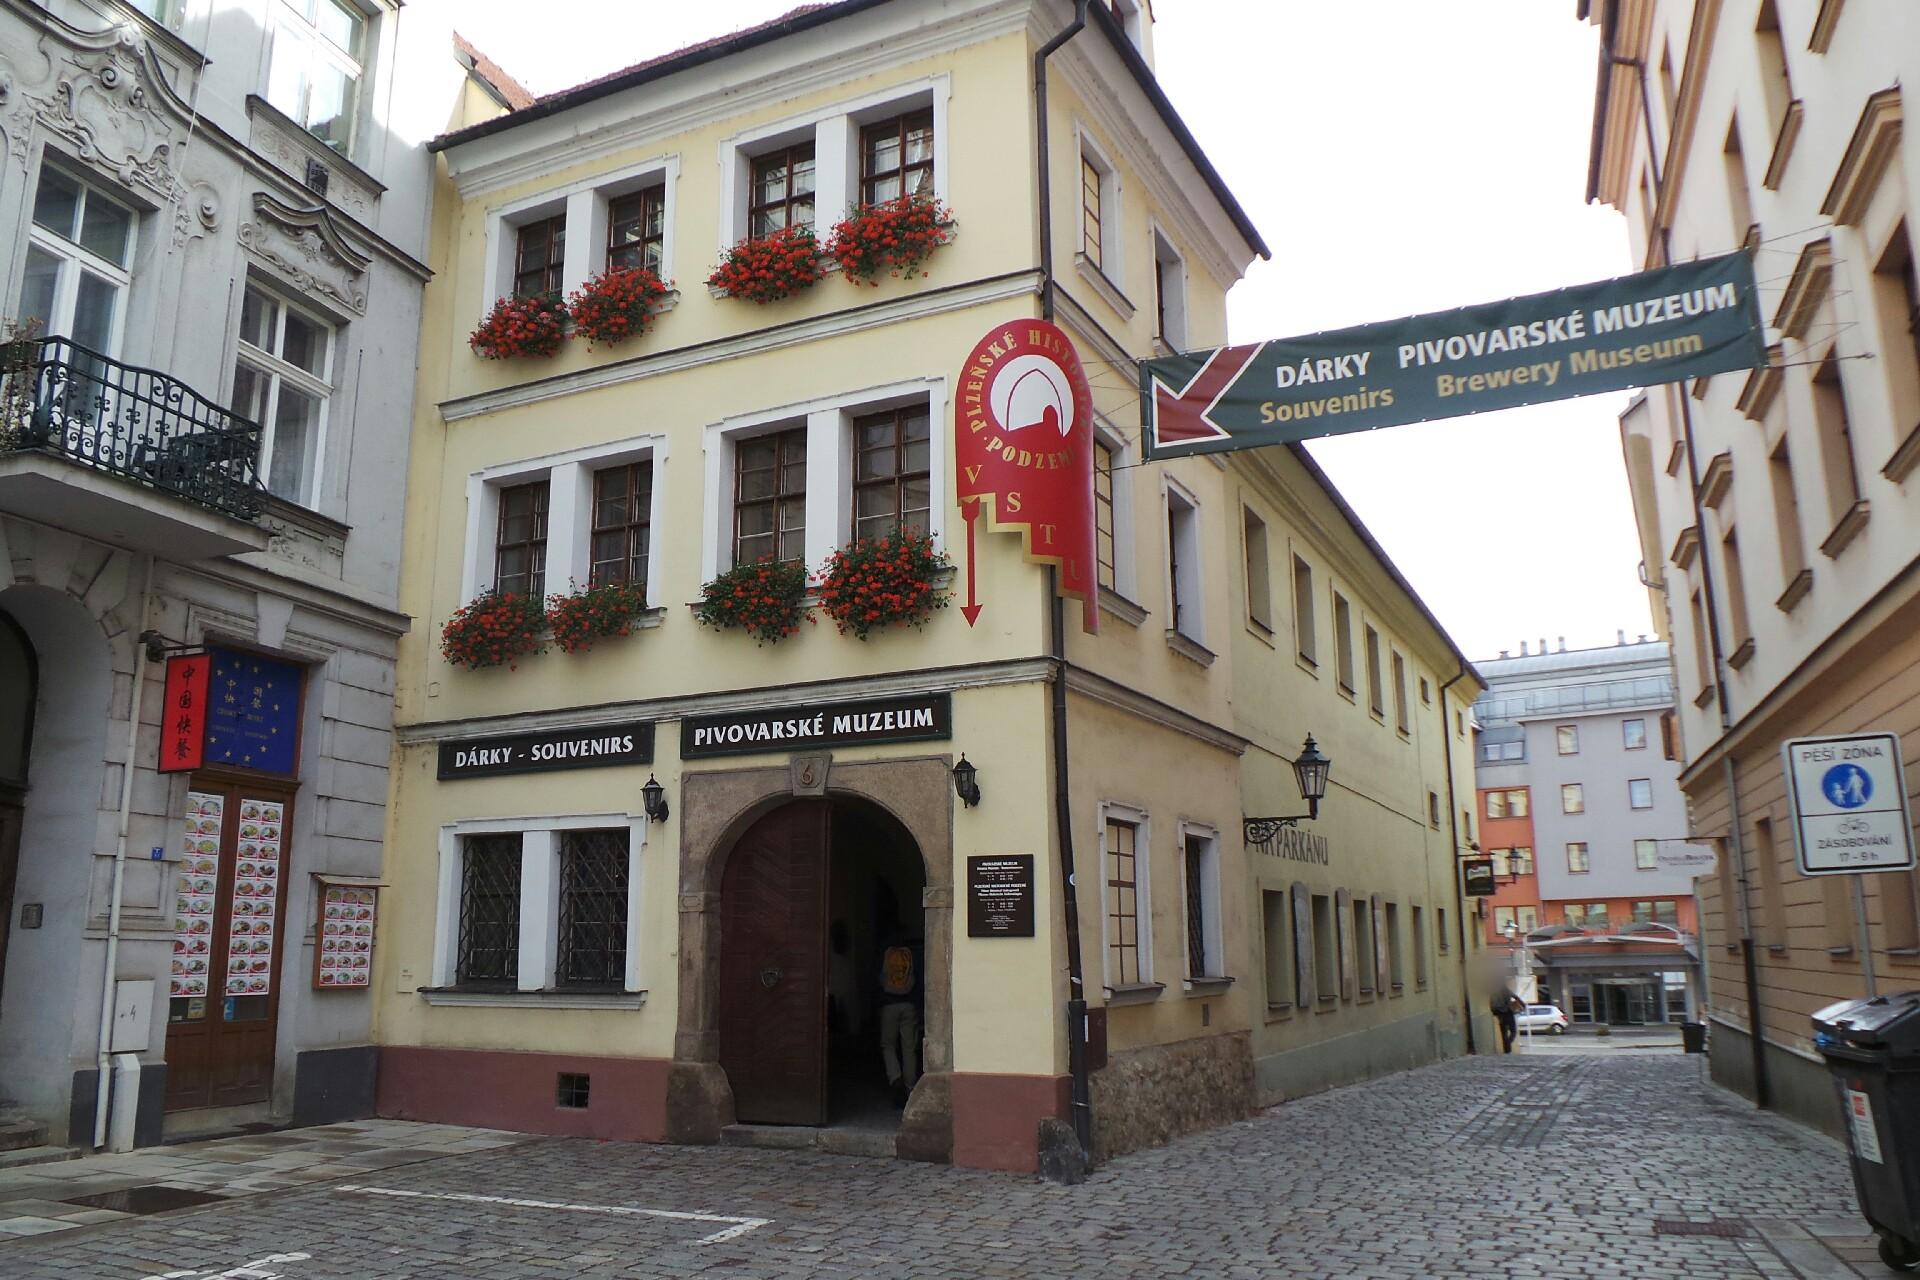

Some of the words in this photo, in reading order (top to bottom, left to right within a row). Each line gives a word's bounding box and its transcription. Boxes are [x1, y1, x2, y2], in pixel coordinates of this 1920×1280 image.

[1276, 351, 1370, 388] DÁRKY
[1398, 309, 1586, 369] PIVOVARSKÉ
[1593, 282, 1738, 335] MUZEUM
[965, 331, 1017, 434] PLZEŇSKÉ
[1260, 386, 1394, 424] Souvenirs
[1437, 358, 1562, 398] Brewery
[1570, 334, 1703, 375] Museum
[985, 435, 1076, 469] PODZEM
[694, 712, 824, 746] PIVOVARSKÉ
[832, 708, 934, 734] MUZEUM
[455, 746, 512, 768] DÁRKY
[531, 735, 634, 761] SOUVENIRS
[801, 764, 814, 785] 6
